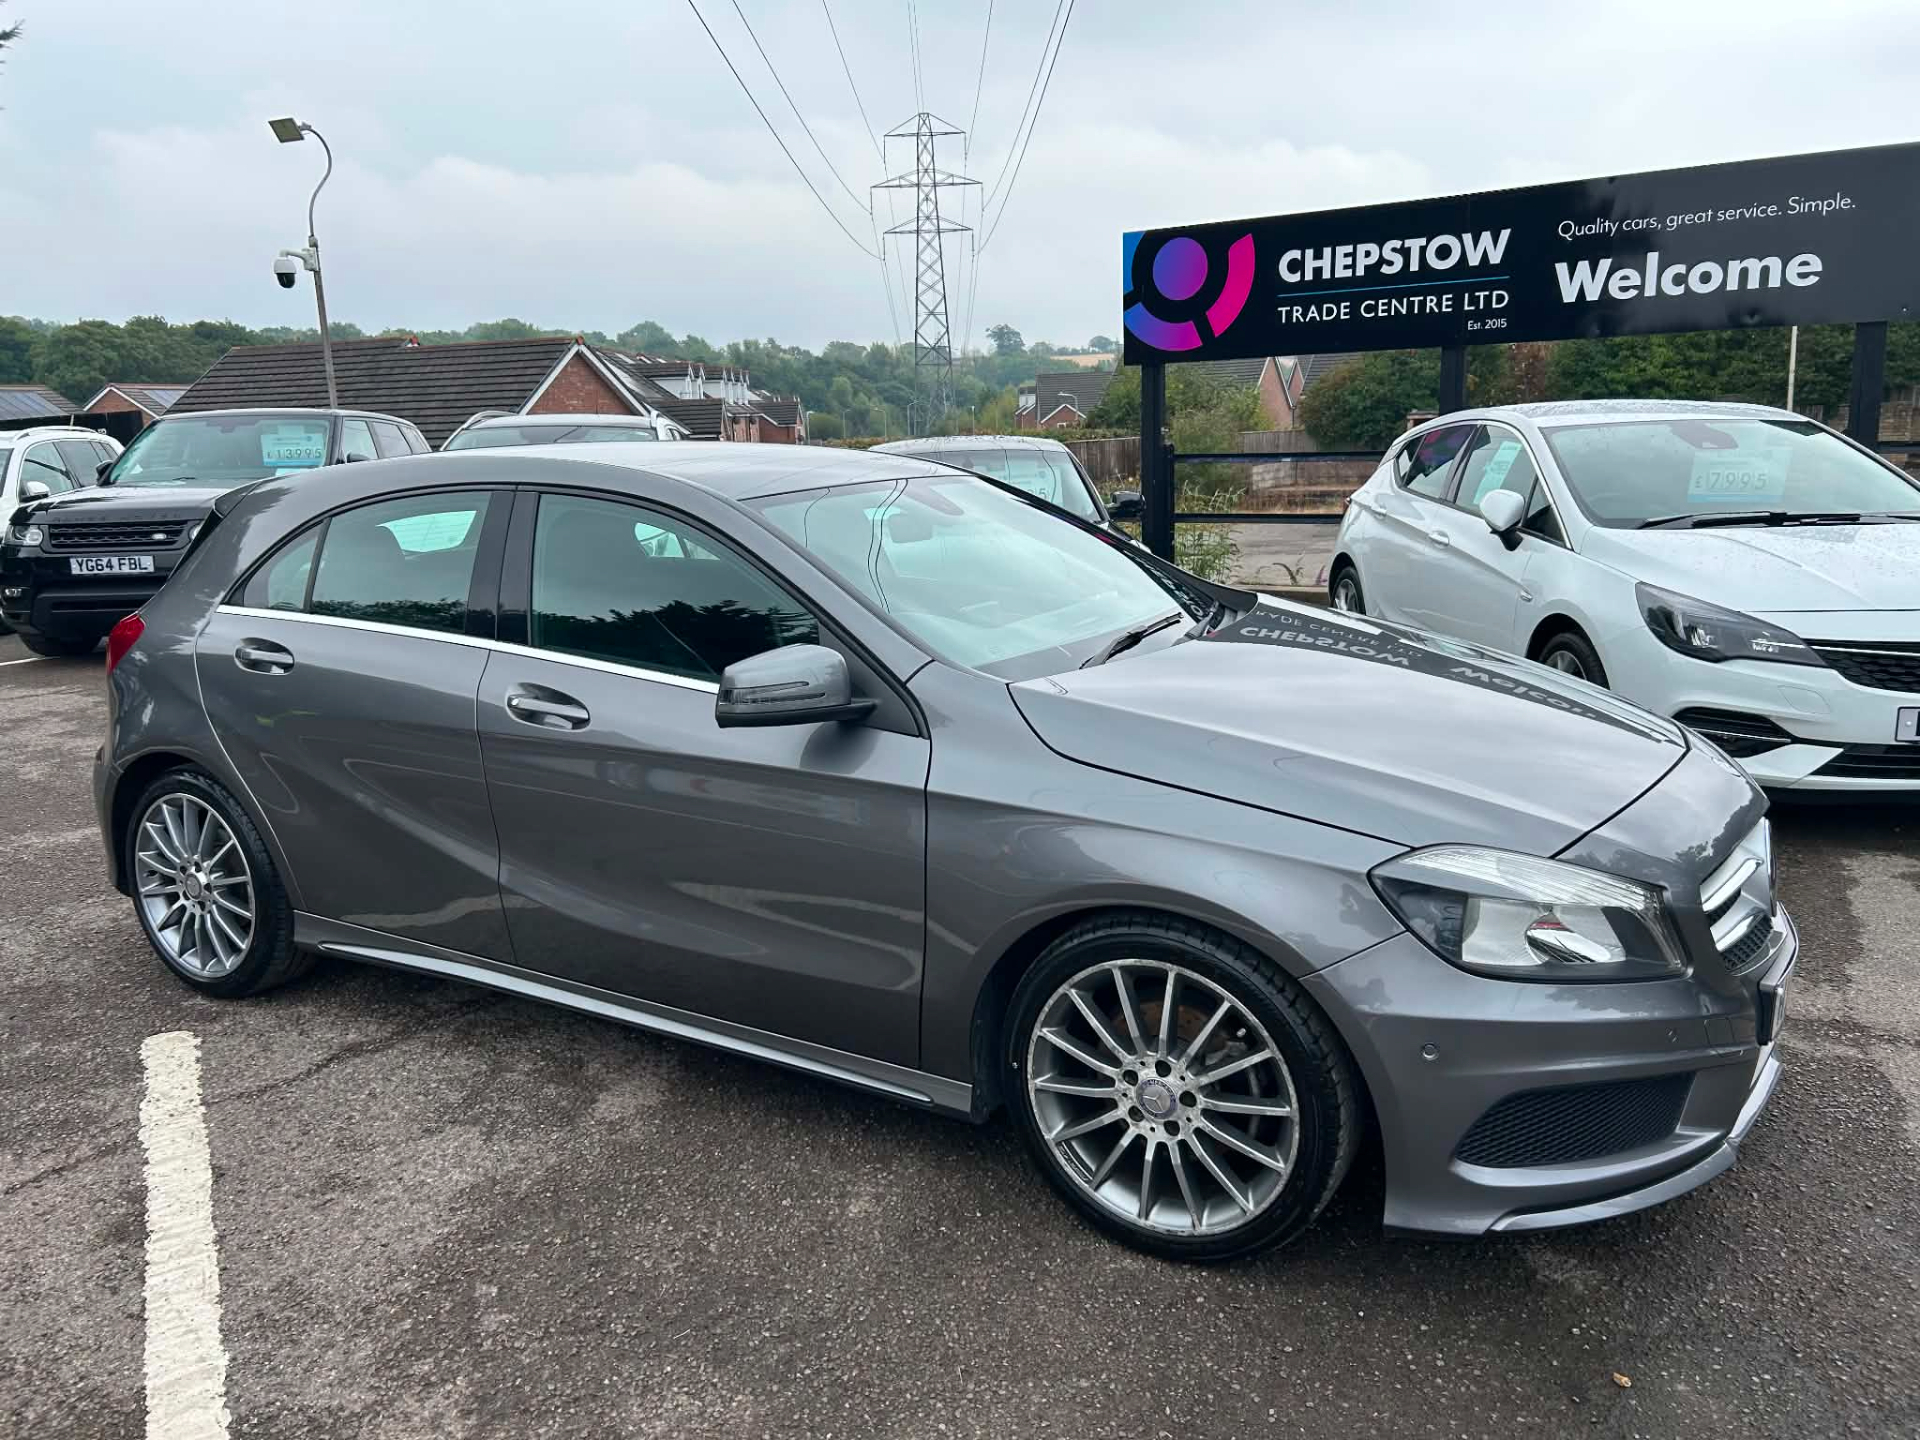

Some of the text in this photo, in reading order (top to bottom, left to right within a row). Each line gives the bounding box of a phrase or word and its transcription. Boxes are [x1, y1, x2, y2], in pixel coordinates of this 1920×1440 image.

[1558, 192, 1856, 241] Quality cars, great service. Simple.
[1278, 227, 1511, 282] CHEPSTOW
[1554, 251, 1823, 303] Welcome
[1277, 290, 1509, 323] TRADE CENTRE LTD
[1467, 318, 1508, 330] Est. 2015
[76, 557, 149, 572] YG64 FBL
